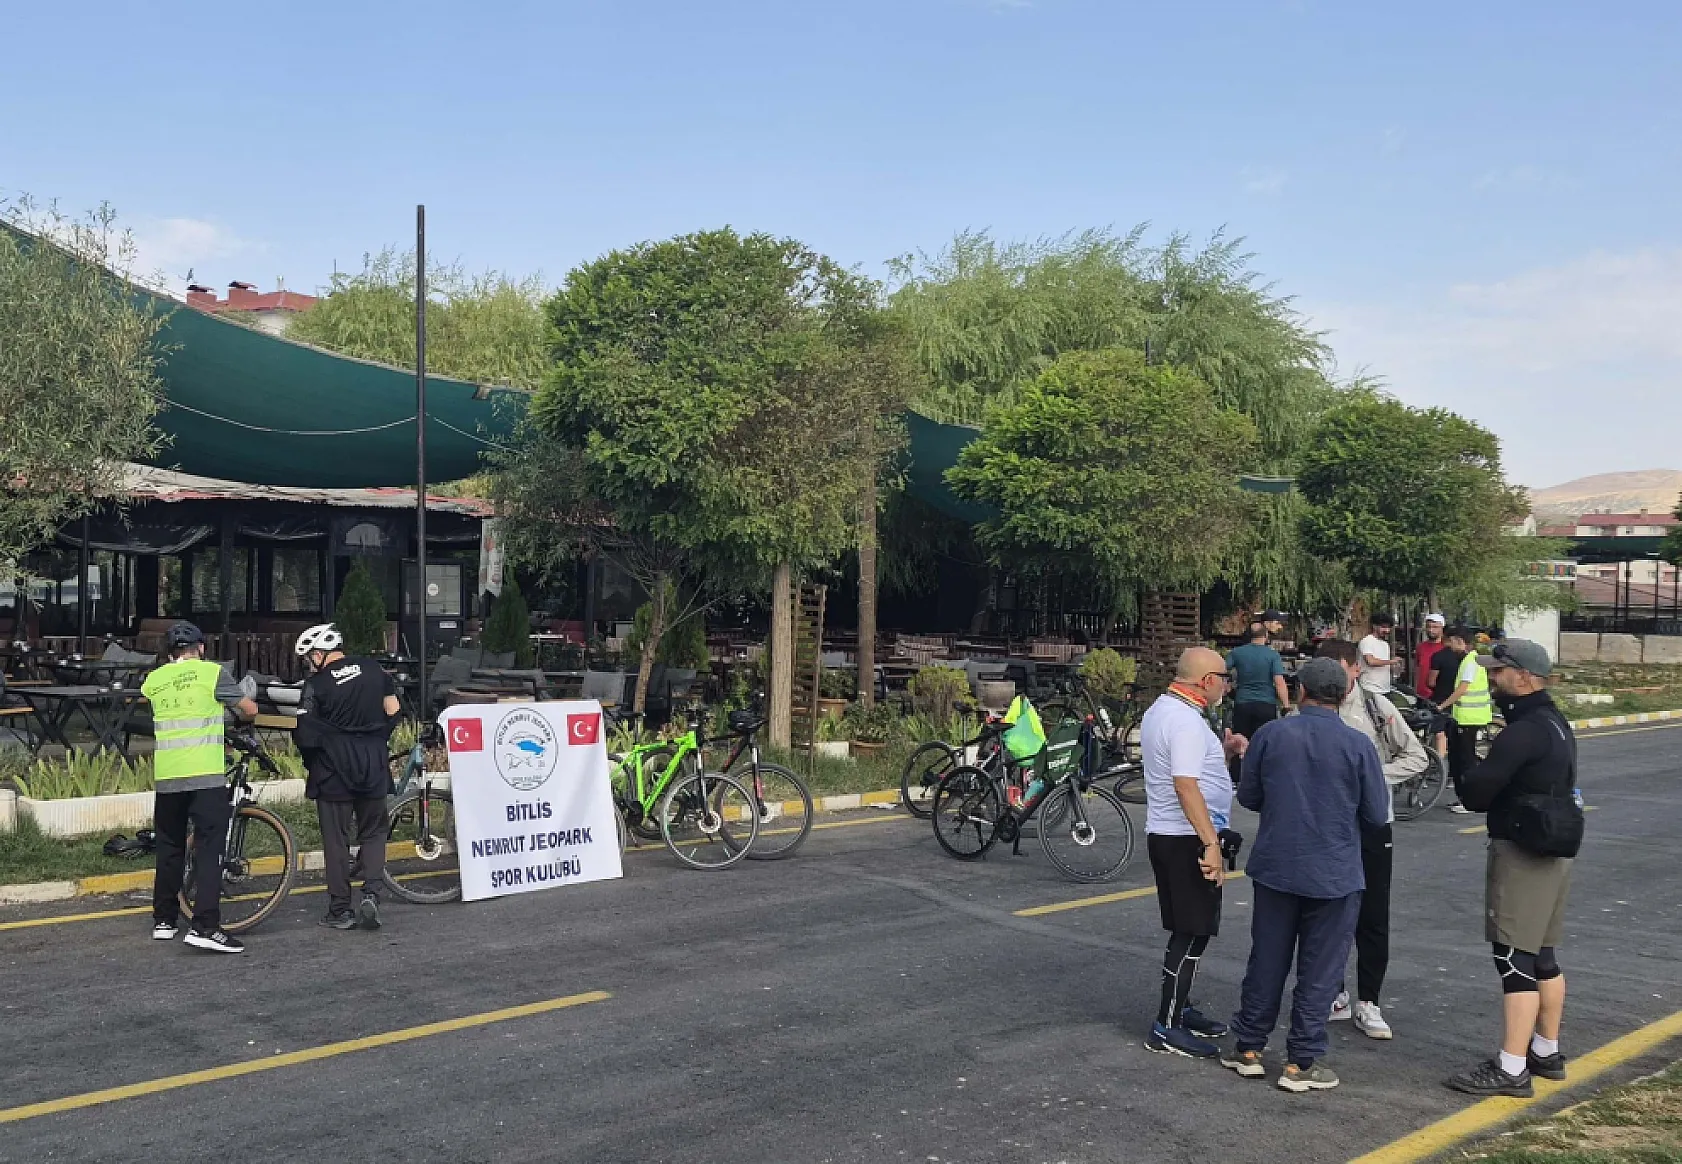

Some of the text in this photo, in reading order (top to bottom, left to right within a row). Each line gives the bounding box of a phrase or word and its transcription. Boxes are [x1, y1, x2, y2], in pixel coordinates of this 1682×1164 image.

[506, 798, 553, 822] BİTLİS
[472, 826, 593, 858] NEMRUT JEOPARK
[491, 855, 581, 888] SPOR KULÜBÜ
